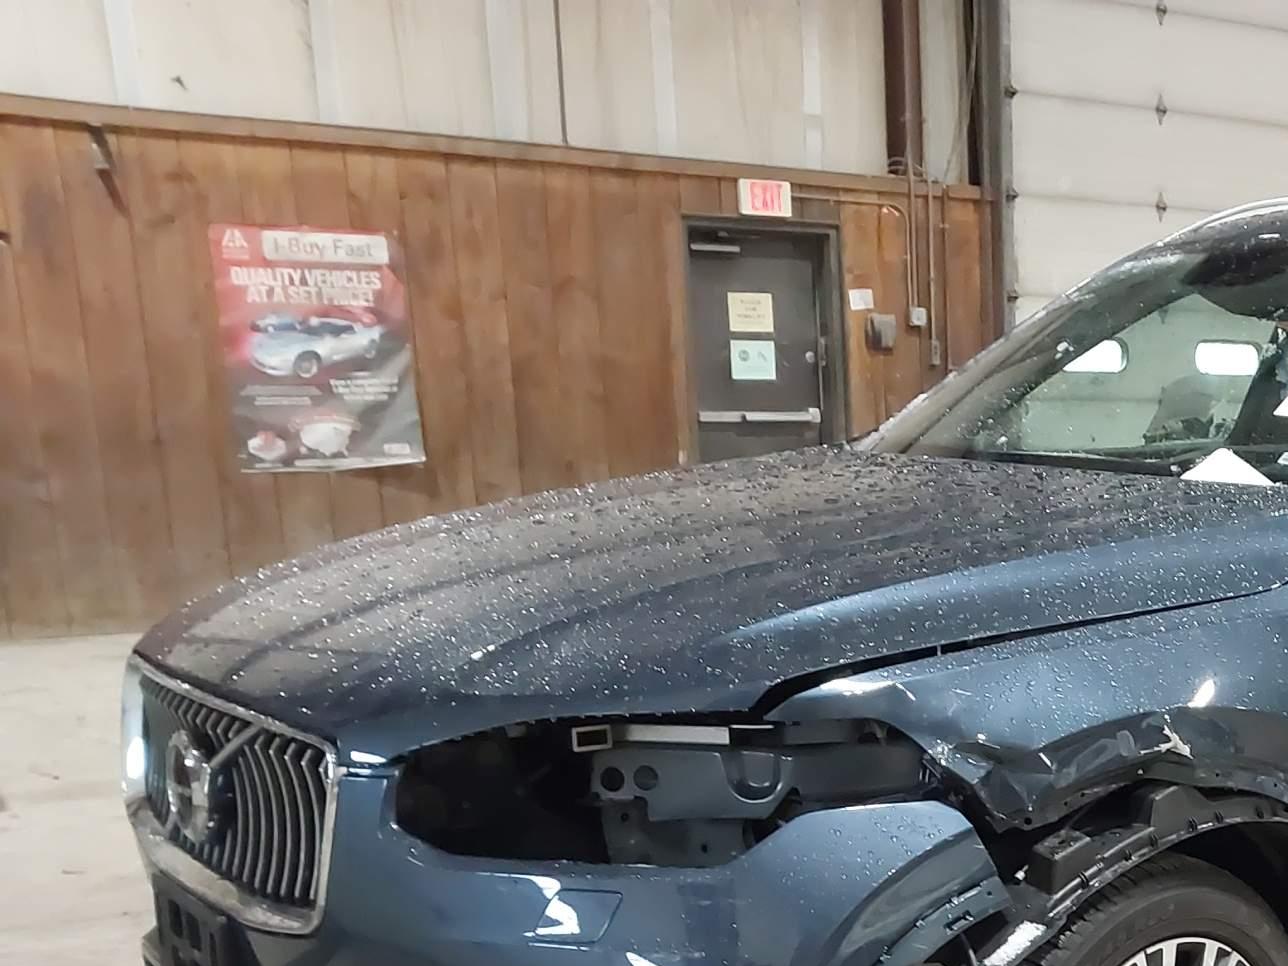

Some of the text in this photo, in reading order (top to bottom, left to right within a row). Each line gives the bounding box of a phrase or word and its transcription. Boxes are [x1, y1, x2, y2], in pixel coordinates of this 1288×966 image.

[750, 181, 783, 212] EXIT
[333, 239, 374, 257] Fast
[230, 266, 382, 289] QUALITY VEHICLES
[246, 286, 269, 303] AT
[272, 286, 286, 304] A
[288, 286, 319, 305] SET
